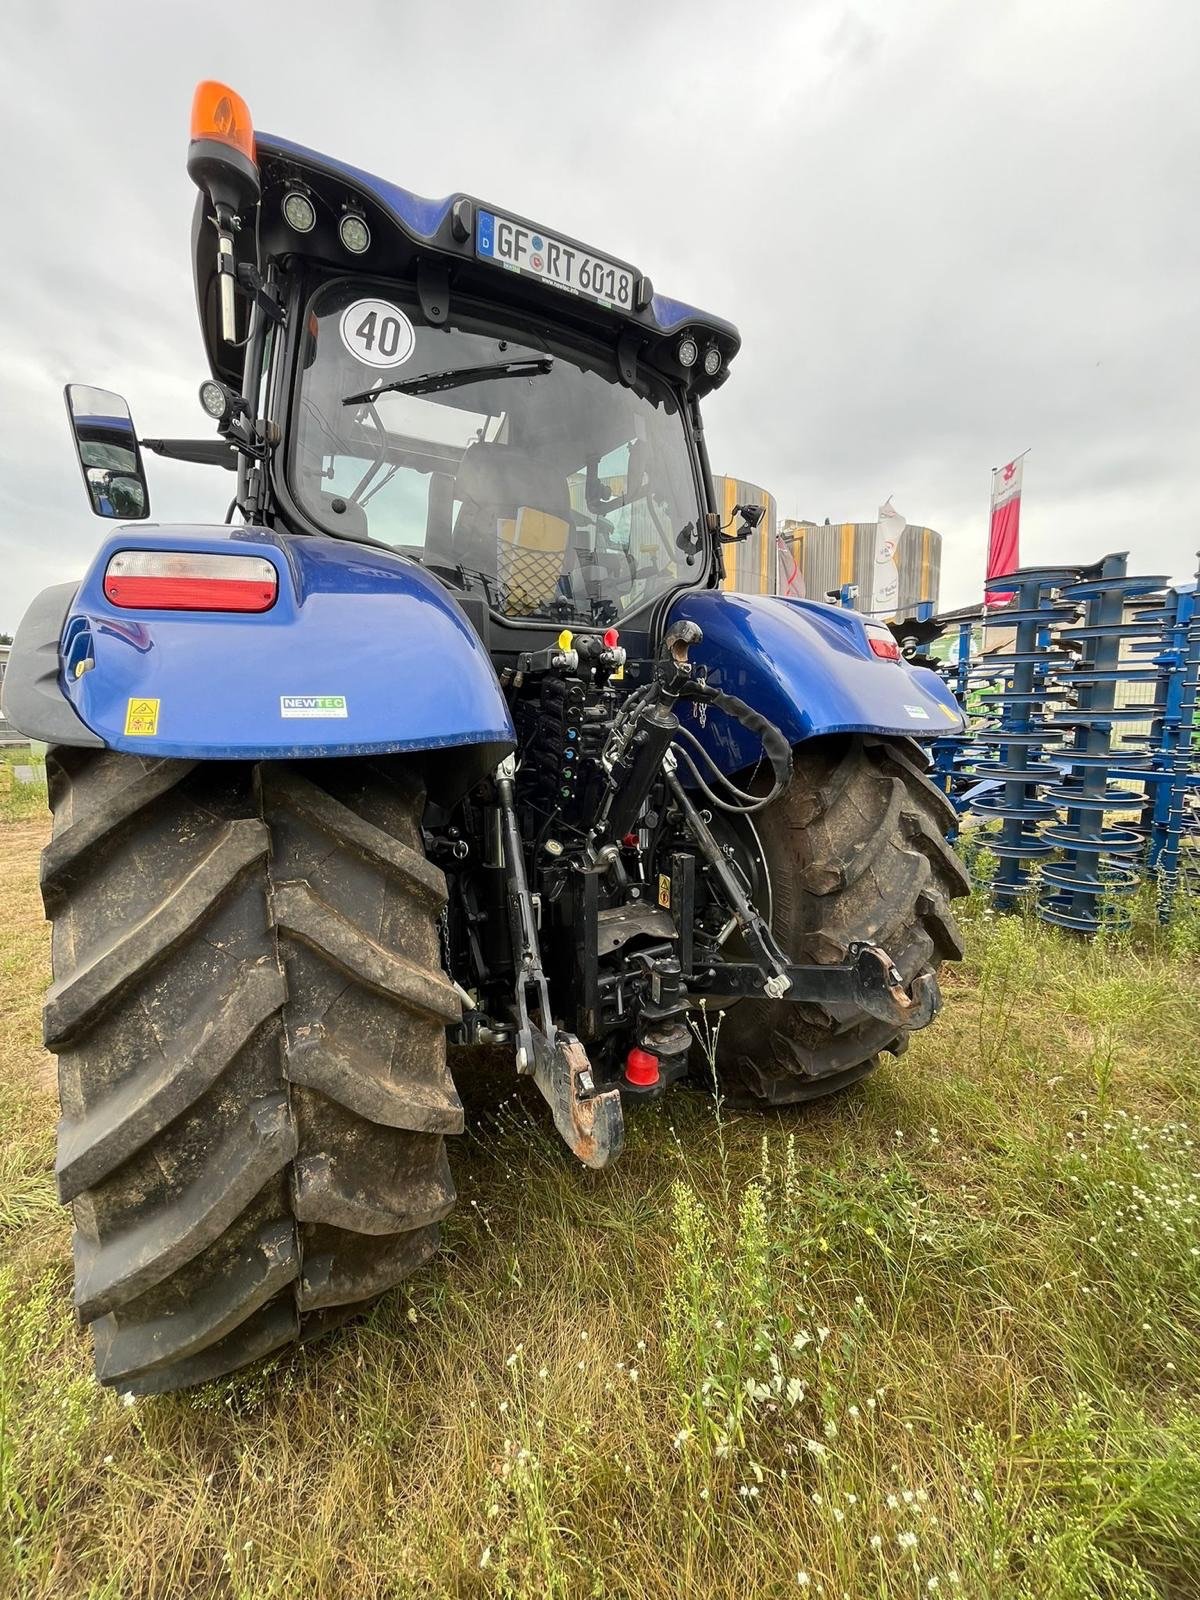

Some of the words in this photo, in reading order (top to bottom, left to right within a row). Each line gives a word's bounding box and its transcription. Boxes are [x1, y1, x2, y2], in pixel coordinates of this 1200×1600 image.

[482, 236, 490, 249] D
[498, 223, 528, 261] GF
[547, 242, 575, 282] RT
[579, 259, 629, 304] 6018
[356, 311, 401, 357] 40
[284, 699, 343, 708] NEWTEC
